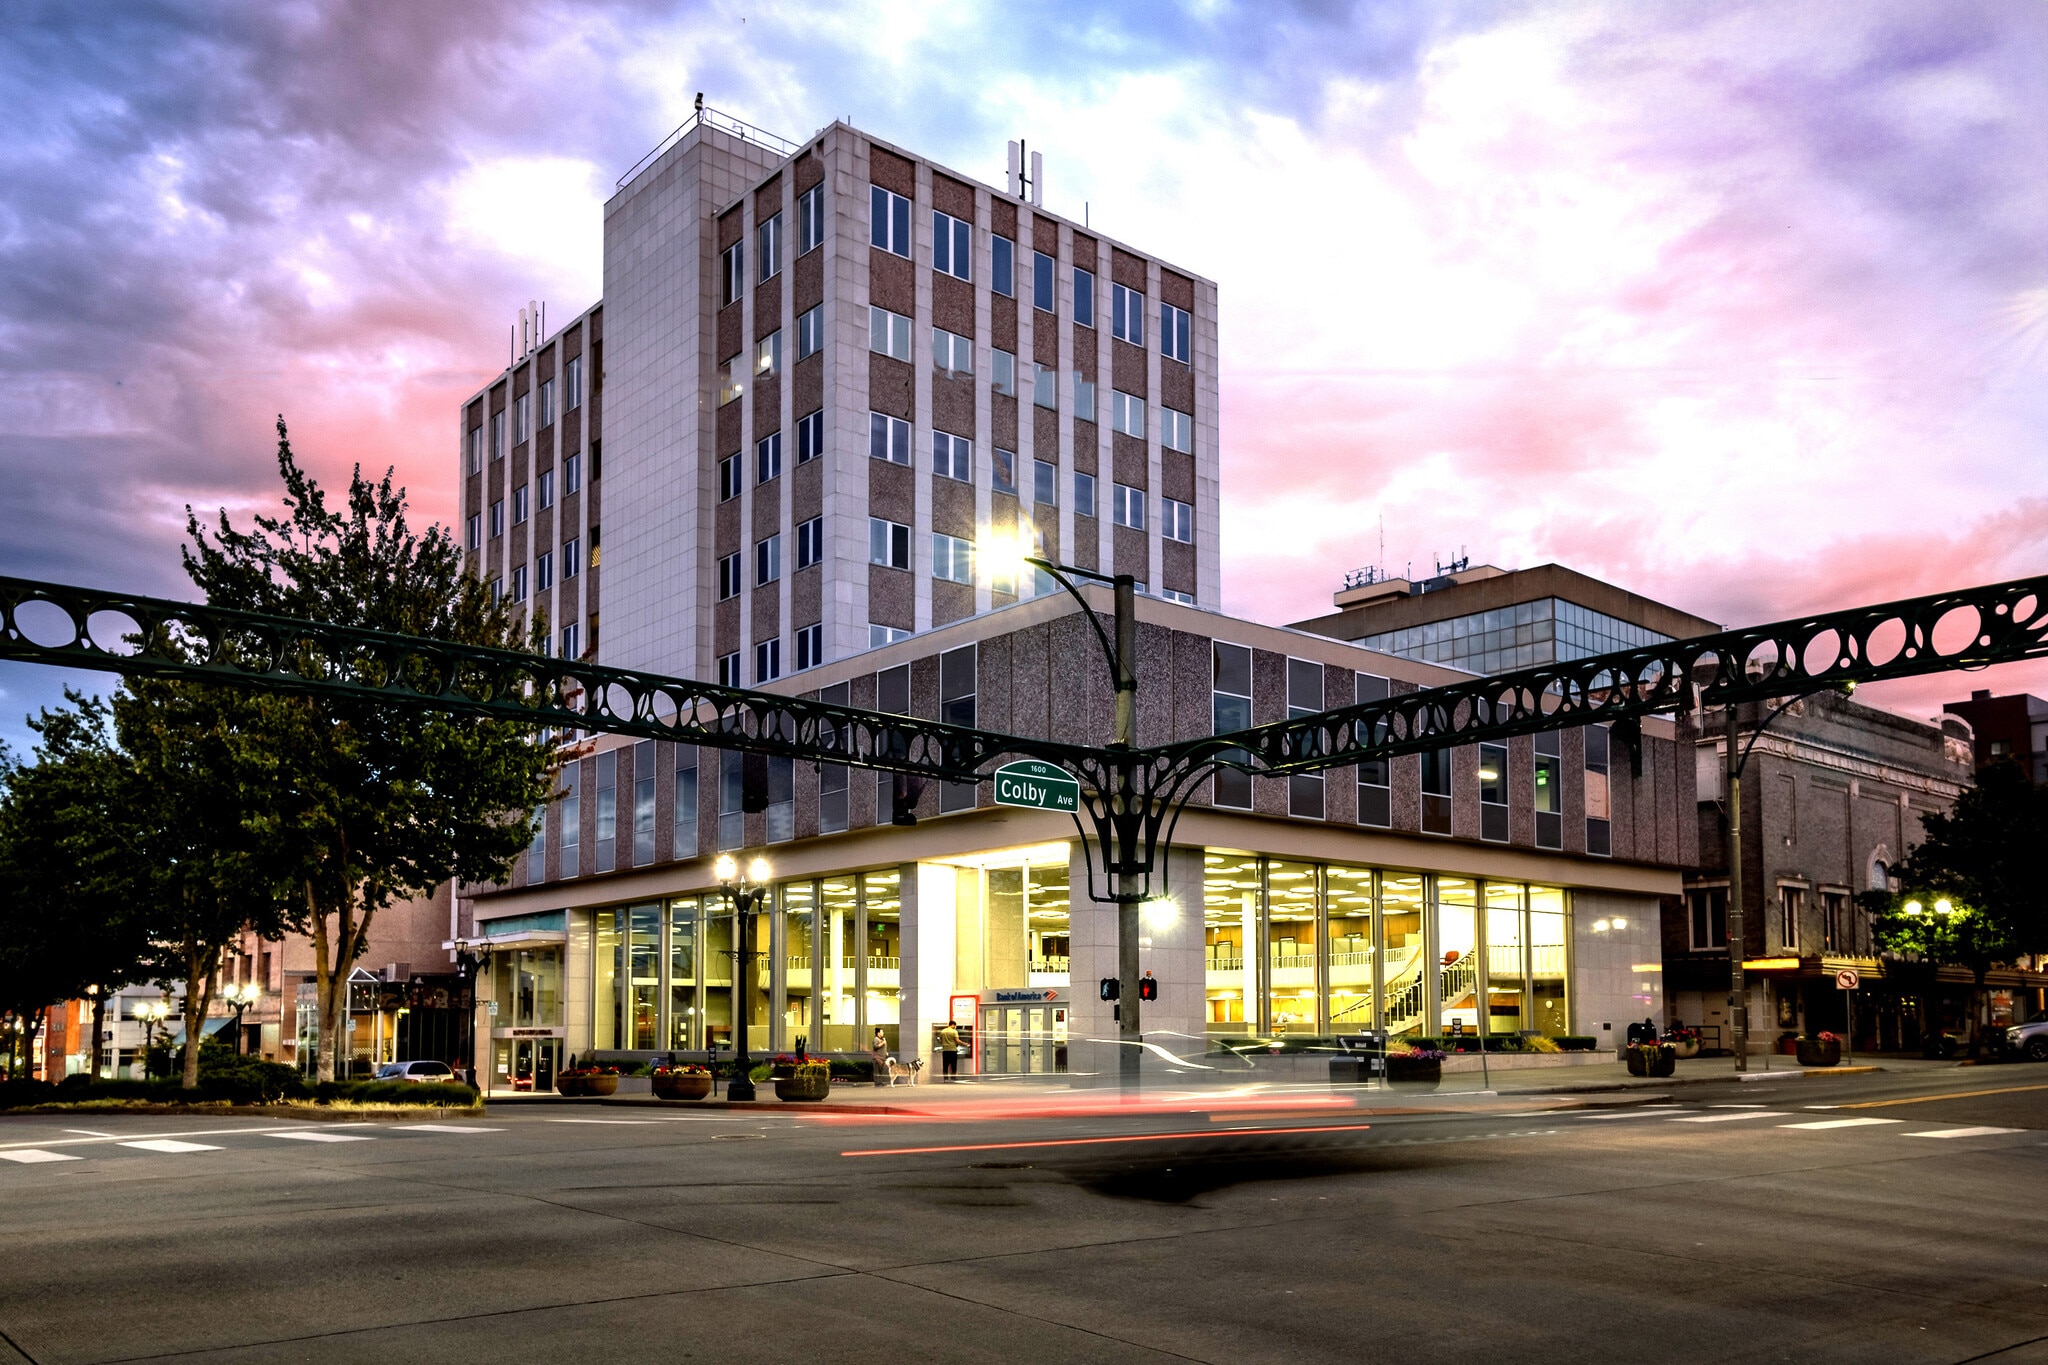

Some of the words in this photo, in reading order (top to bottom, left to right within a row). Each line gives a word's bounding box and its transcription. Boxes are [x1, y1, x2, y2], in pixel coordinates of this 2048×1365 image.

[1031, 765, 1047, 774] 1600
[1001, 779, 1047, 806] Colby
[1057, 795, 1073, 806] Ave
[1018, 991, 1042, 1001] America
